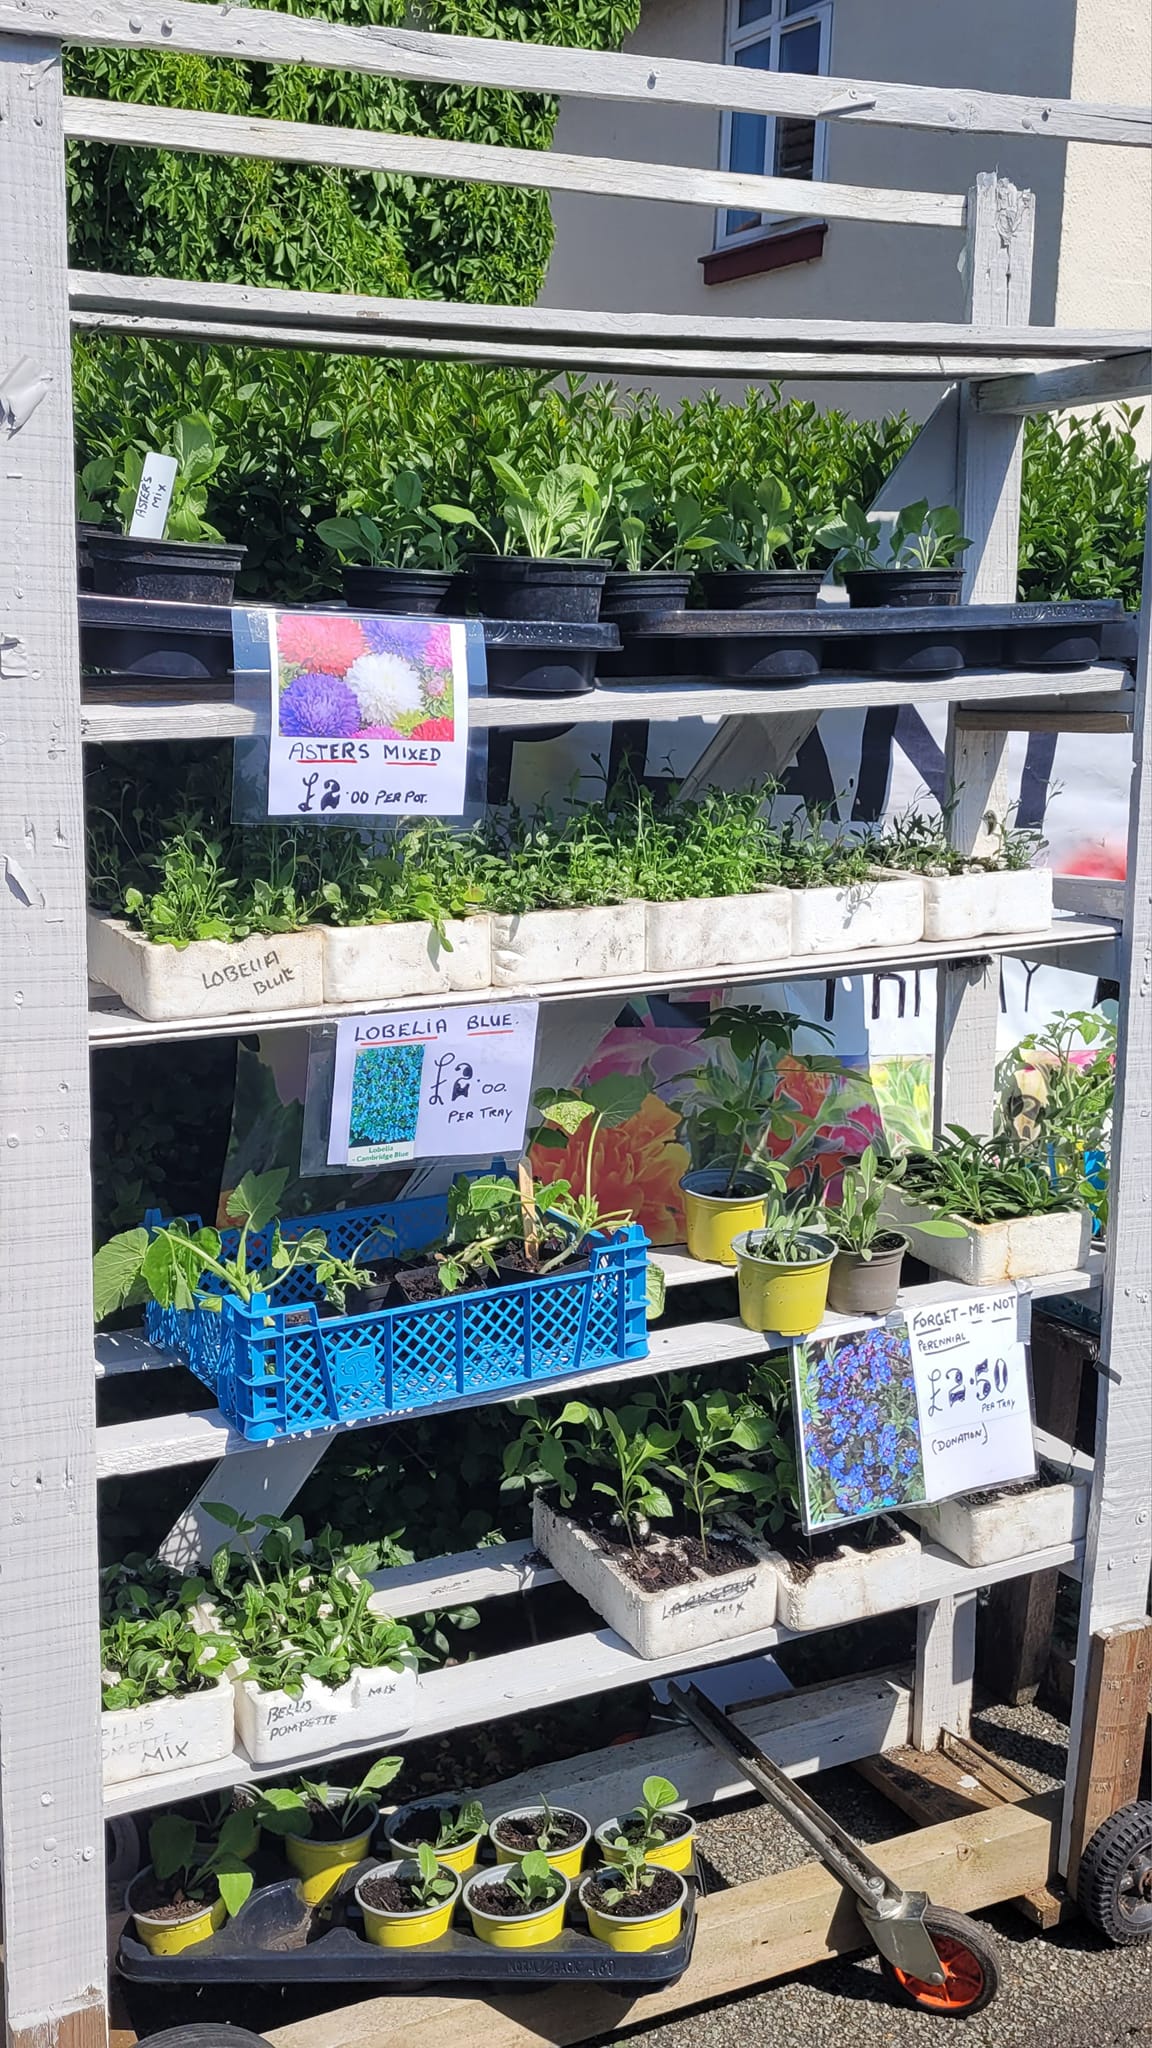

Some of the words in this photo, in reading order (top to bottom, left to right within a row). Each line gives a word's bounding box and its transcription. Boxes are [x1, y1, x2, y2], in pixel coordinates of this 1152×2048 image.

[288, 741, 370, 760] ASTERS
[383, 744, 441, 762] MIXED
[375, 790, 401, 806] PER
[202, 950, 280, 990] LOBELIA
[253, 967, 295, 997] BLUE
[354, 1018, 447, 1042] LOBELIA
[447, 1109, 474, 1124] PER
[480, 1105, 513, 1124] TRAY
[356, 1152, 394, 1163] Cambridge
[394, 1150, 409, 1159] Blue
[368, 1145, 394, 1154] Lobelia
[917, 1331, 967, 1353] PERENNIAL
[981, 1402, 995, 1413] PER
[996, 1399, 1016, 1410] TRAY
[101, 1718, 154, 1741] ELLIS
[141, 1740, 189, 1764] MIX
